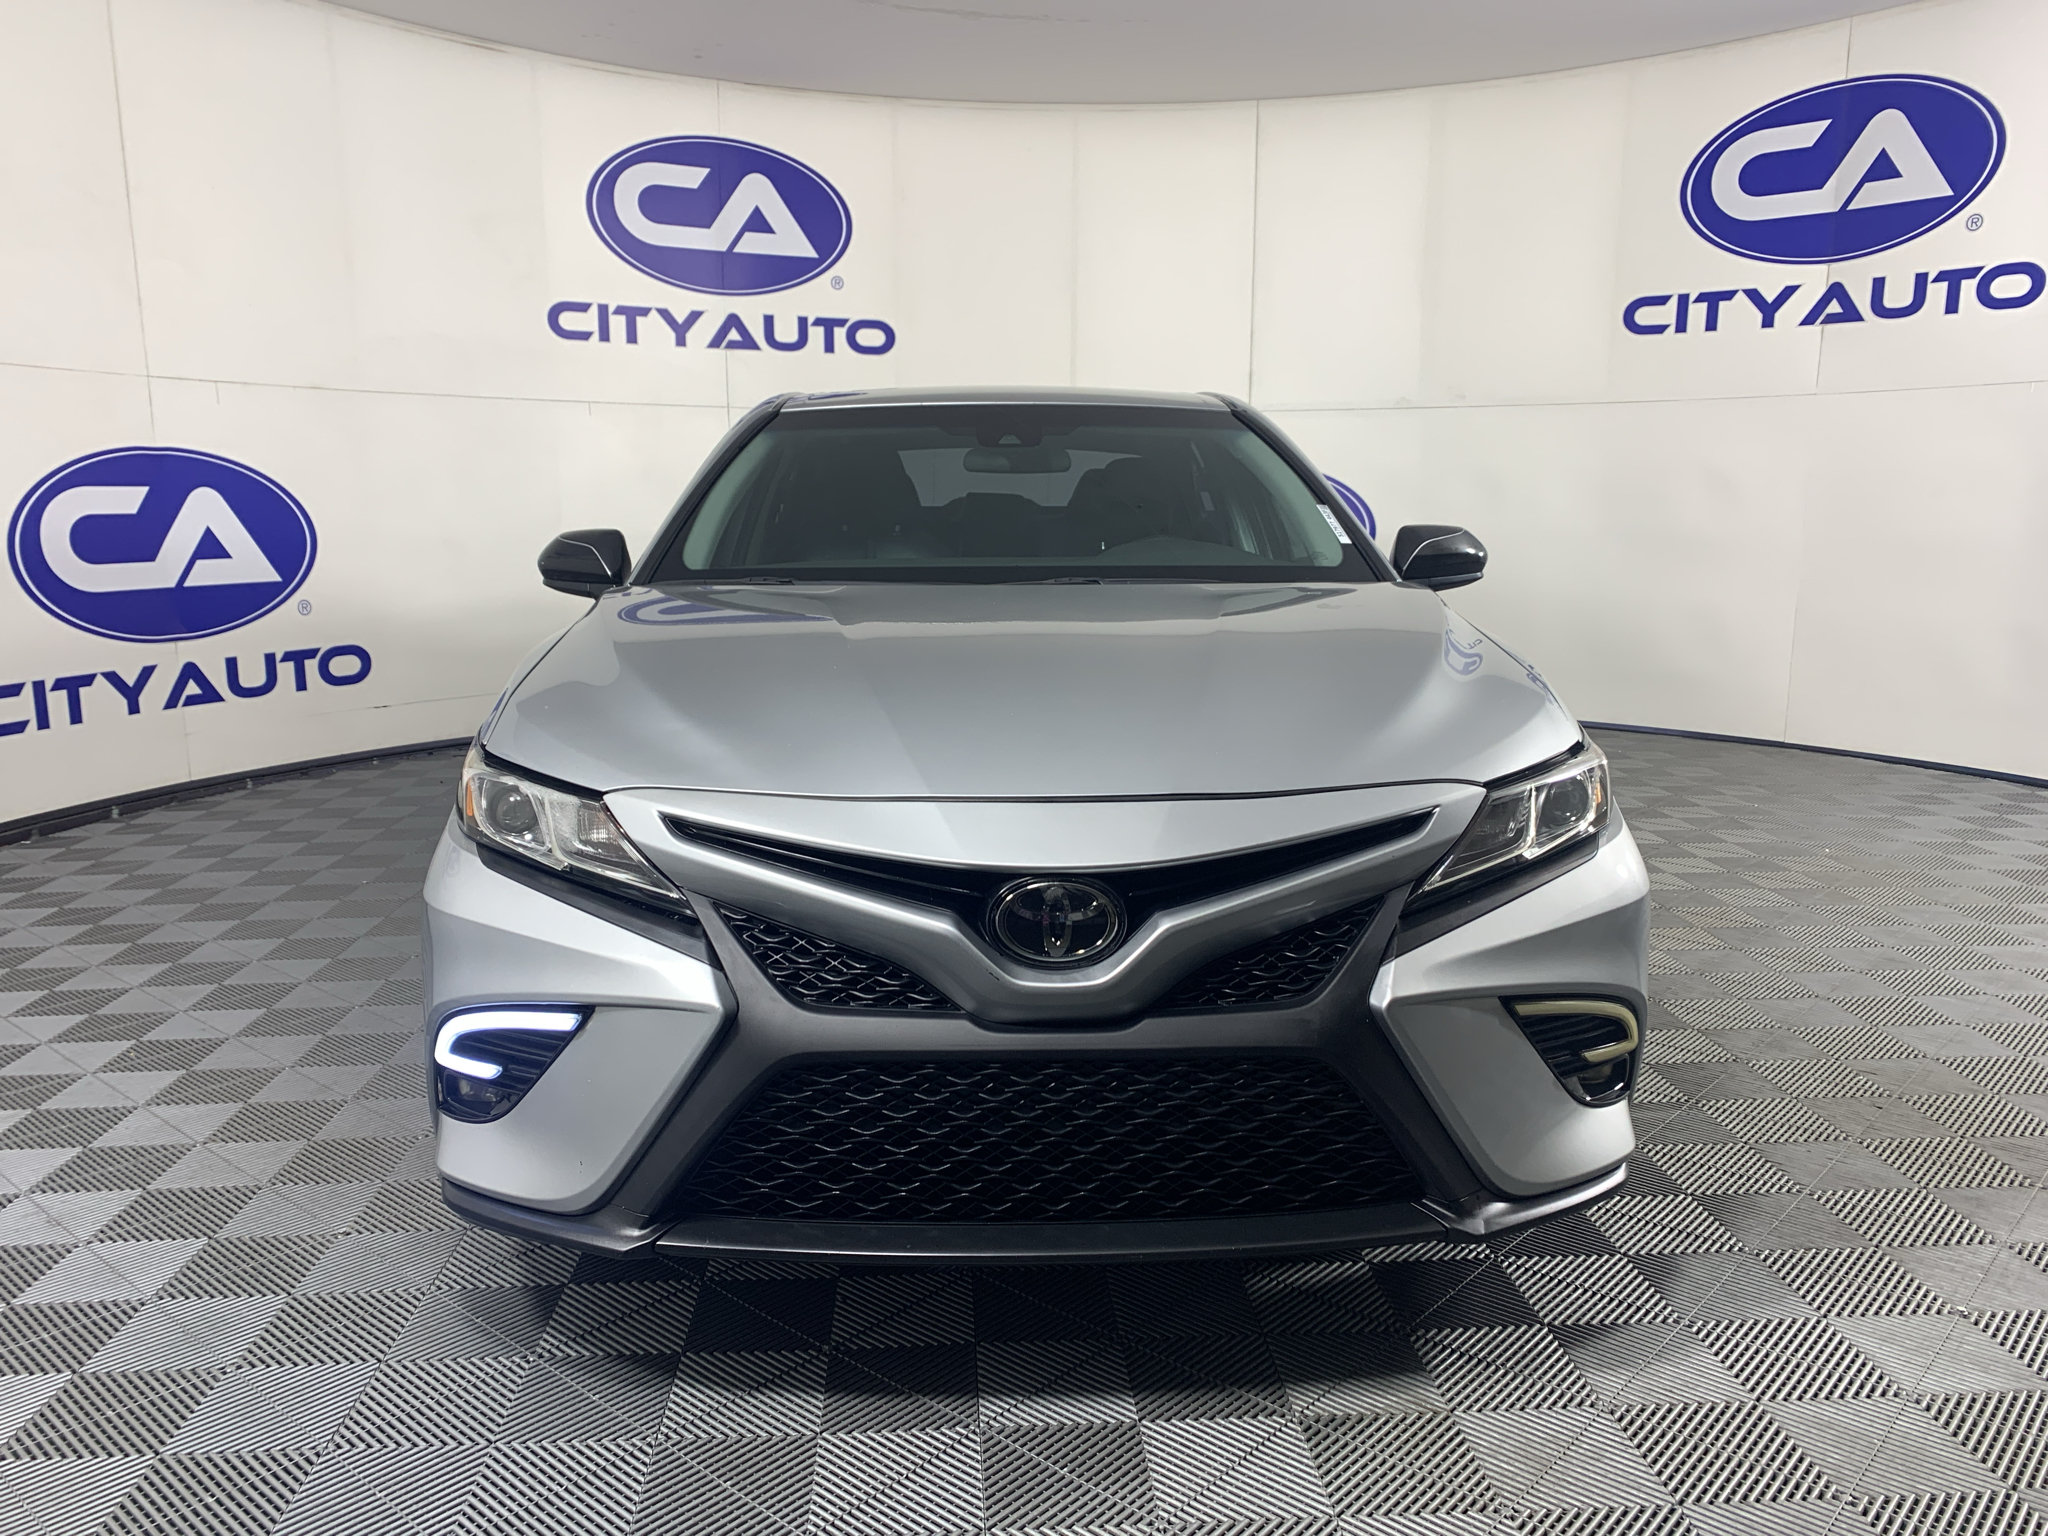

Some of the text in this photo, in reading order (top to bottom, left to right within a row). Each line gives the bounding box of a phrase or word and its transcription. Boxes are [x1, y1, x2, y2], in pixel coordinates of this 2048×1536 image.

[613, 162, 820, 258] CA
[1711, 108, 1955, 221] CA
[40, 485, 283, 593] CA
